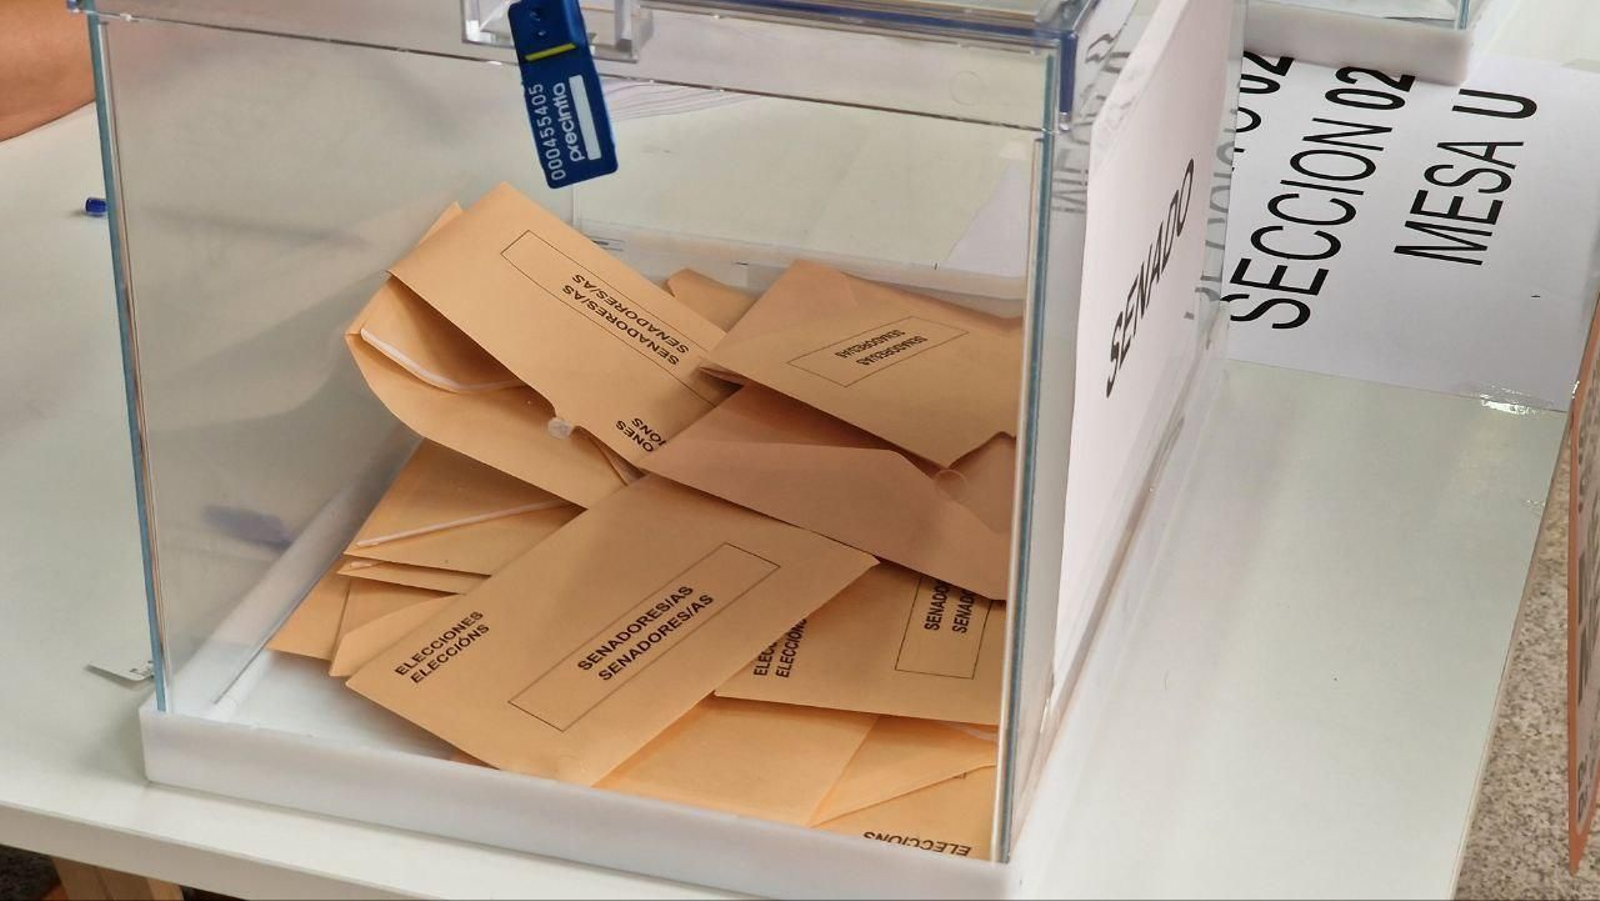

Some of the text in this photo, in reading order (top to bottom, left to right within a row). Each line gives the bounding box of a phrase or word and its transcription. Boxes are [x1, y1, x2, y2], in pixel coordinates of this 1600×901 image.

[528, 84, 566, 181] 000455405
[1220, 65, 1416, 330] SECCION 02
[1393, 88, 1538, 266] MESA U
[571, 274, 690, 354] SENADORES/AS
[1106, 158, 1195, 399] SENADO
[562, 284, 680, 365] SENADORES/AS
[394, 610, 484, 676] ELECCIONES
[577, 586, 694, 671] SENADORES/AS
[598, 594, 714, 681] SENADORES/AS
[923, 580, 951, 631] SENADO
[410, 624, 490, 684] ELECCIÓNS
